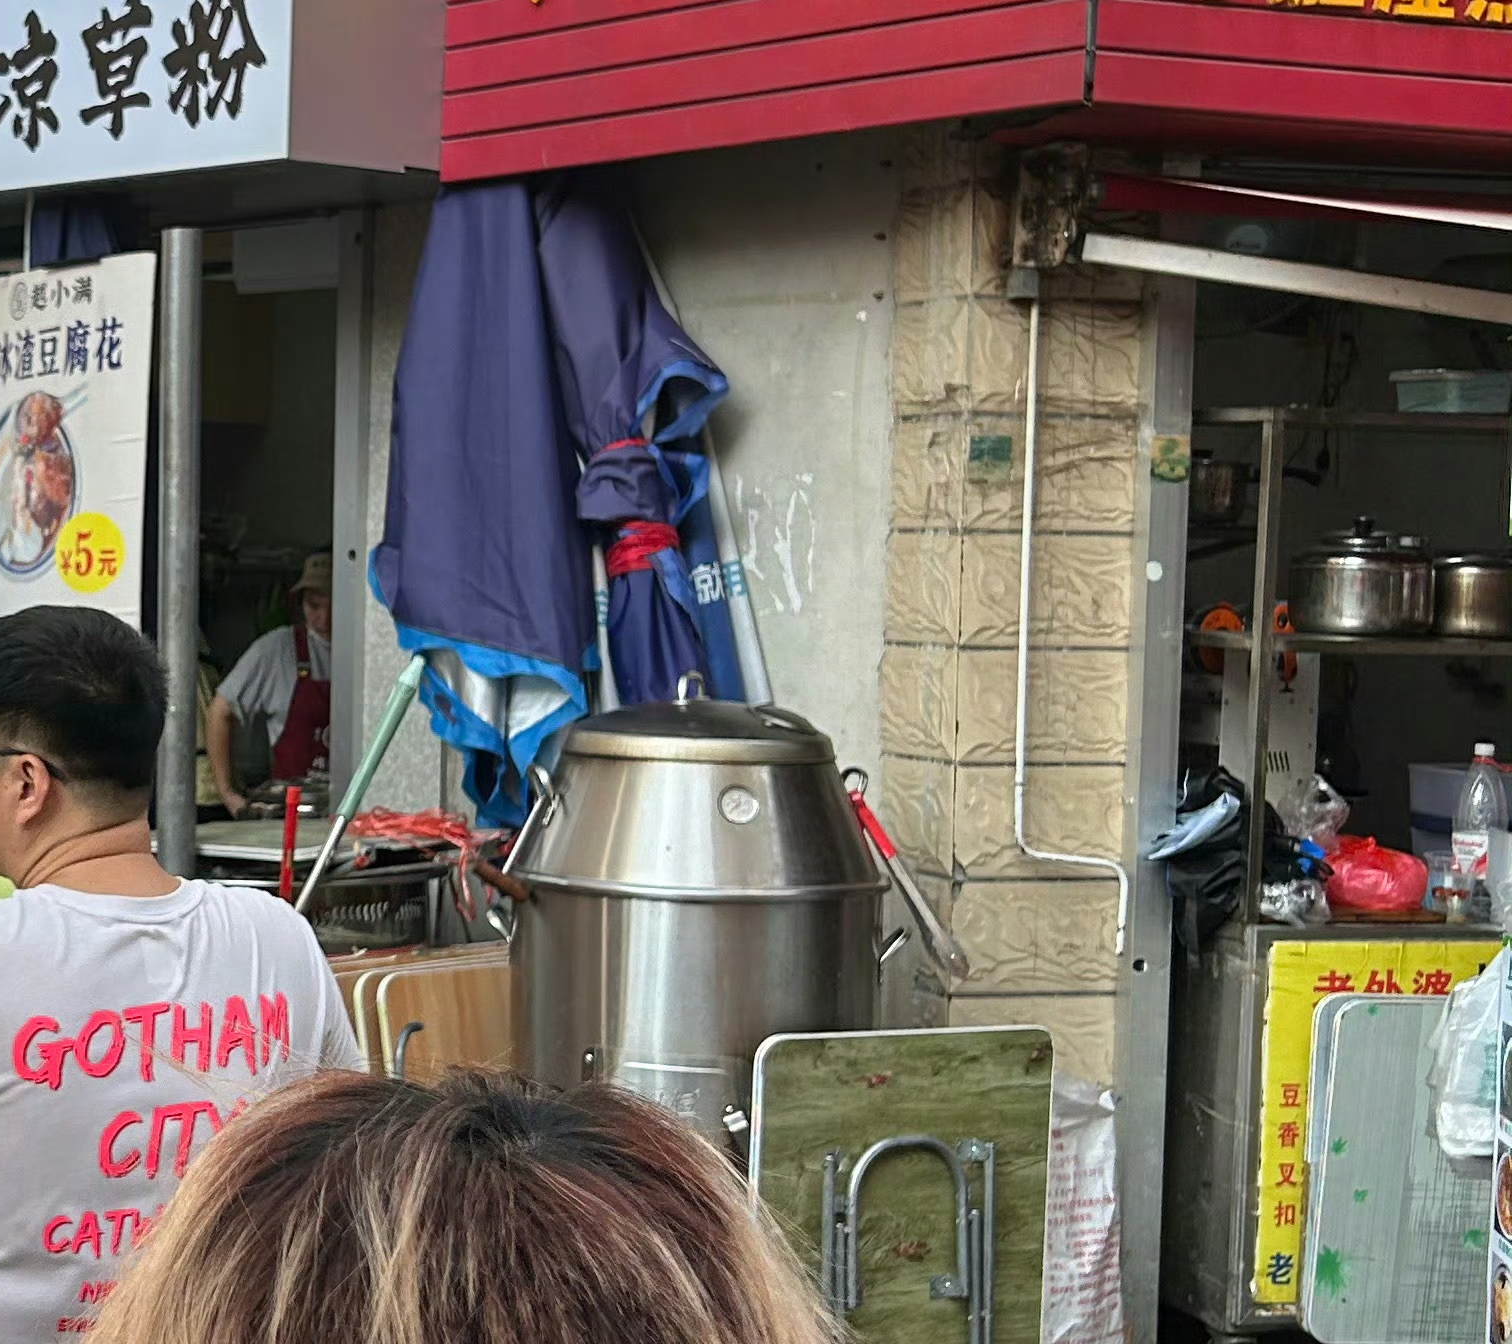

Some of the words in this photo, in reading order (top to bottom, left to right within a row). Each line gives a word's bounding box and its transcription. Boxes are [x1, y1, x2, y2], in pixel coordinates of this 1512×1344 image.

[13, 992, 291, 1090] GOTHAM
[1274, 1083, 1302, 1227] 豆香叉扣
[1266, 1252, 1295, 1286] 老
